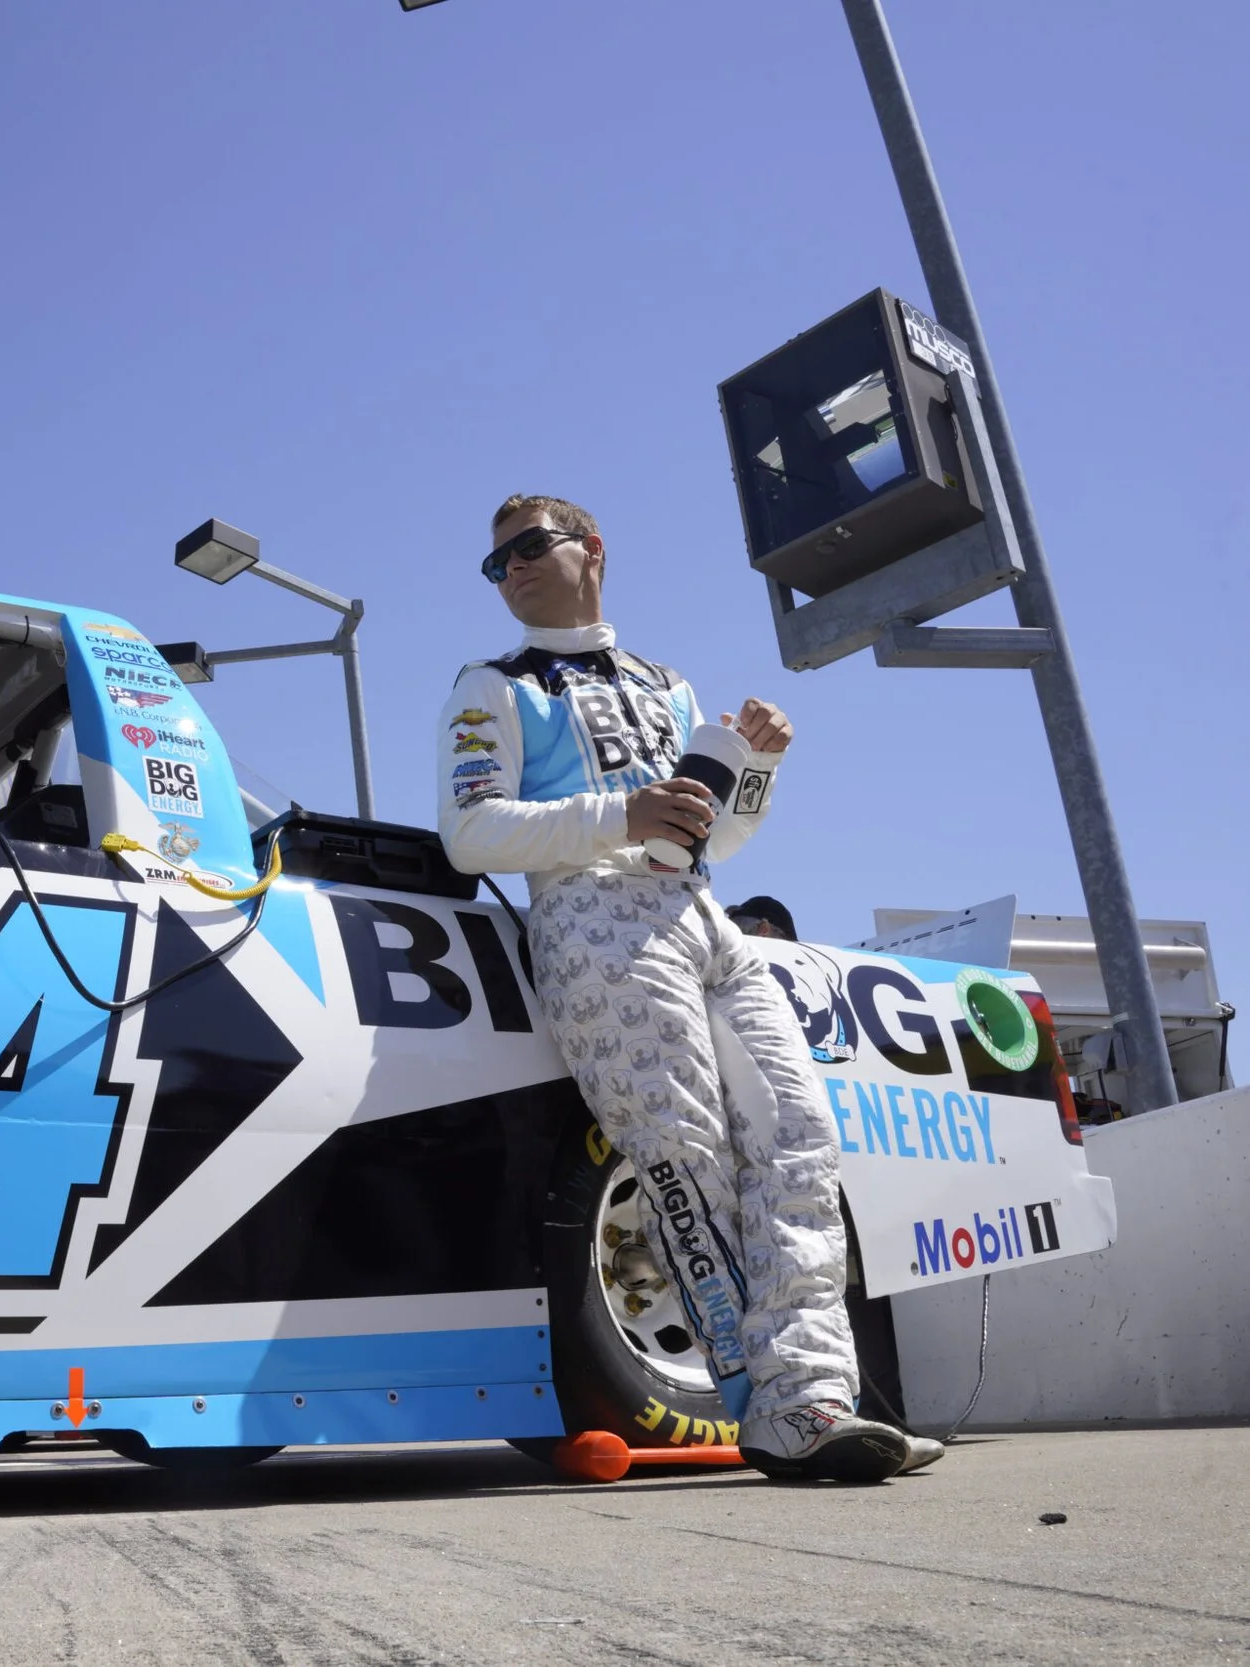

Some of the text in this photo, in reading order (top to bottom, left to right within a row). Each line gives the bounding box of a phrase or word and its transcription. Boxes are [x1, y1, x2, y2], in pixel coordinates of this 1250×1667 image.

[146, 759, 195, 785] BIG
[145, 867, 176, 880] ZRM
[329, 894, 537, 1033] BI
[825, 1078, 995, 1165] ENERGY
[913, 1207, 1023, 1276] Mobil
[634, 1396, 740, 1447] AGLE
